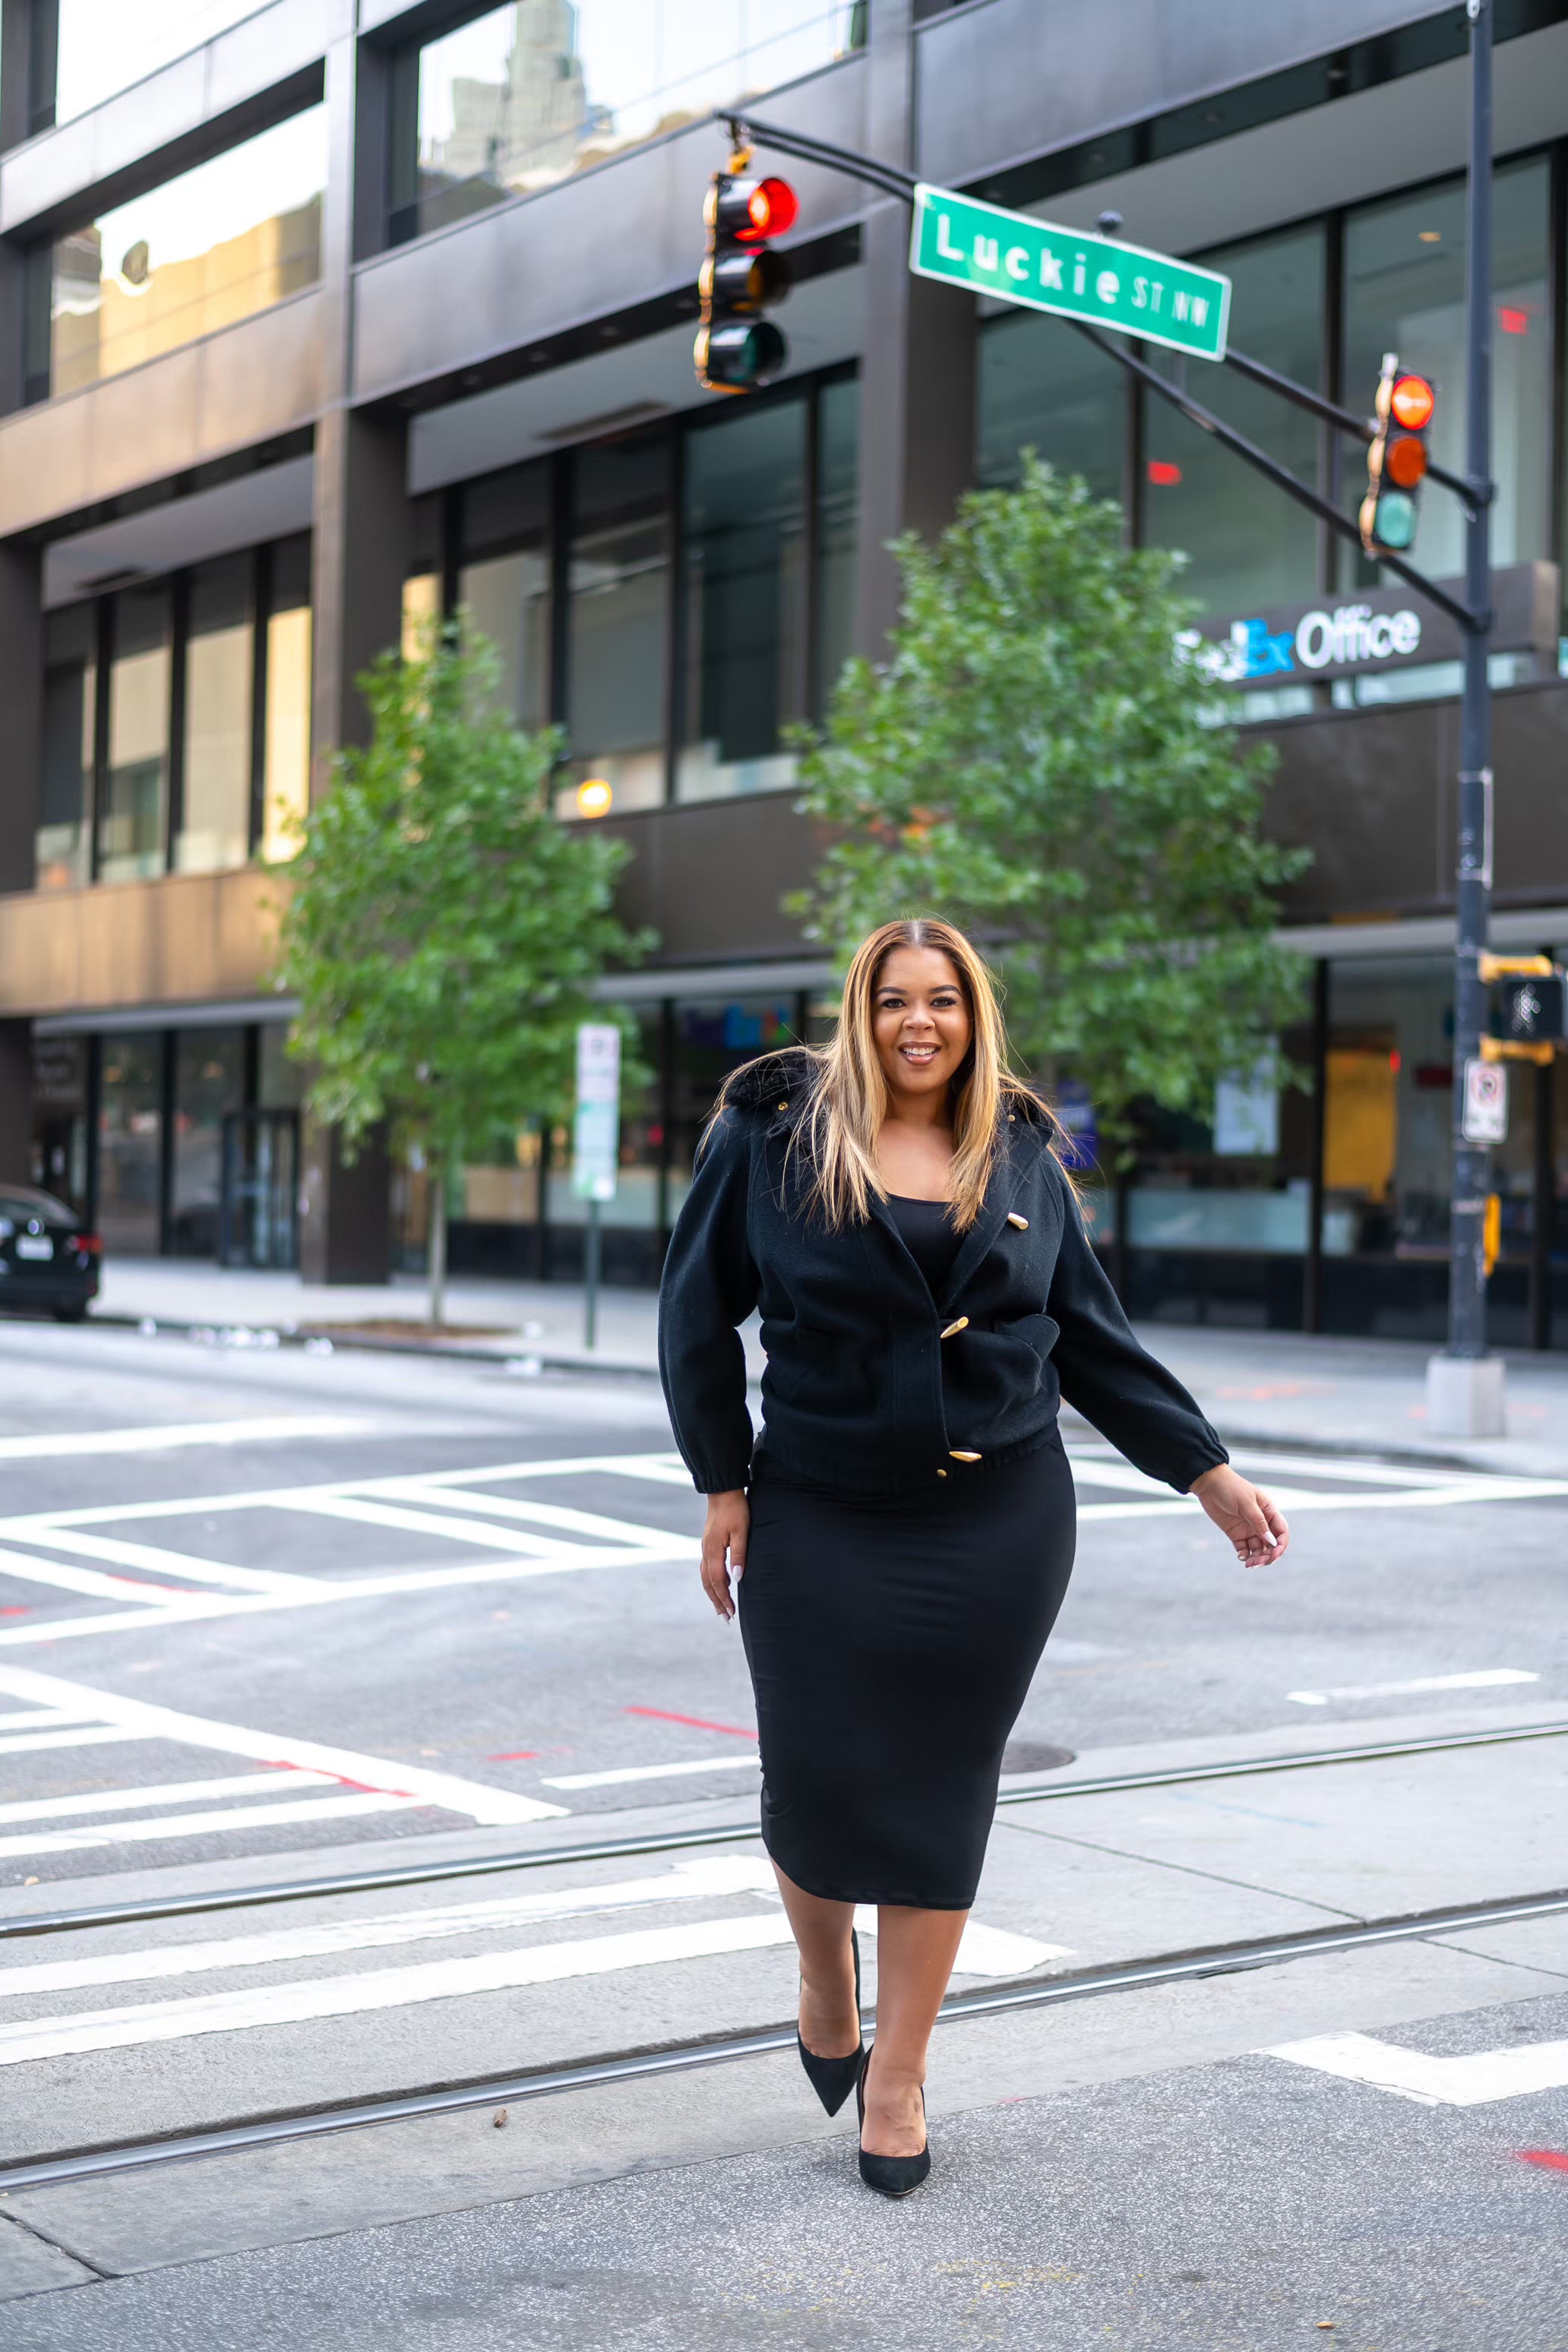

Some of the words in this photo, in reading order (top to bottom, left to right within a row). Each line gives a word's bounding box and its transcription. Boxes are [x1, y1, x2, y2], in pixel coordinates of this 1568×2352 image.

[936, 213, 1121, 305] Luckie
[1130, 276, 1165, 314] ST
[1171, 291, 1210, 327] NW
[1172, 618, 1295, 680] dEx
[1295, 604, 1421, 669] Office
